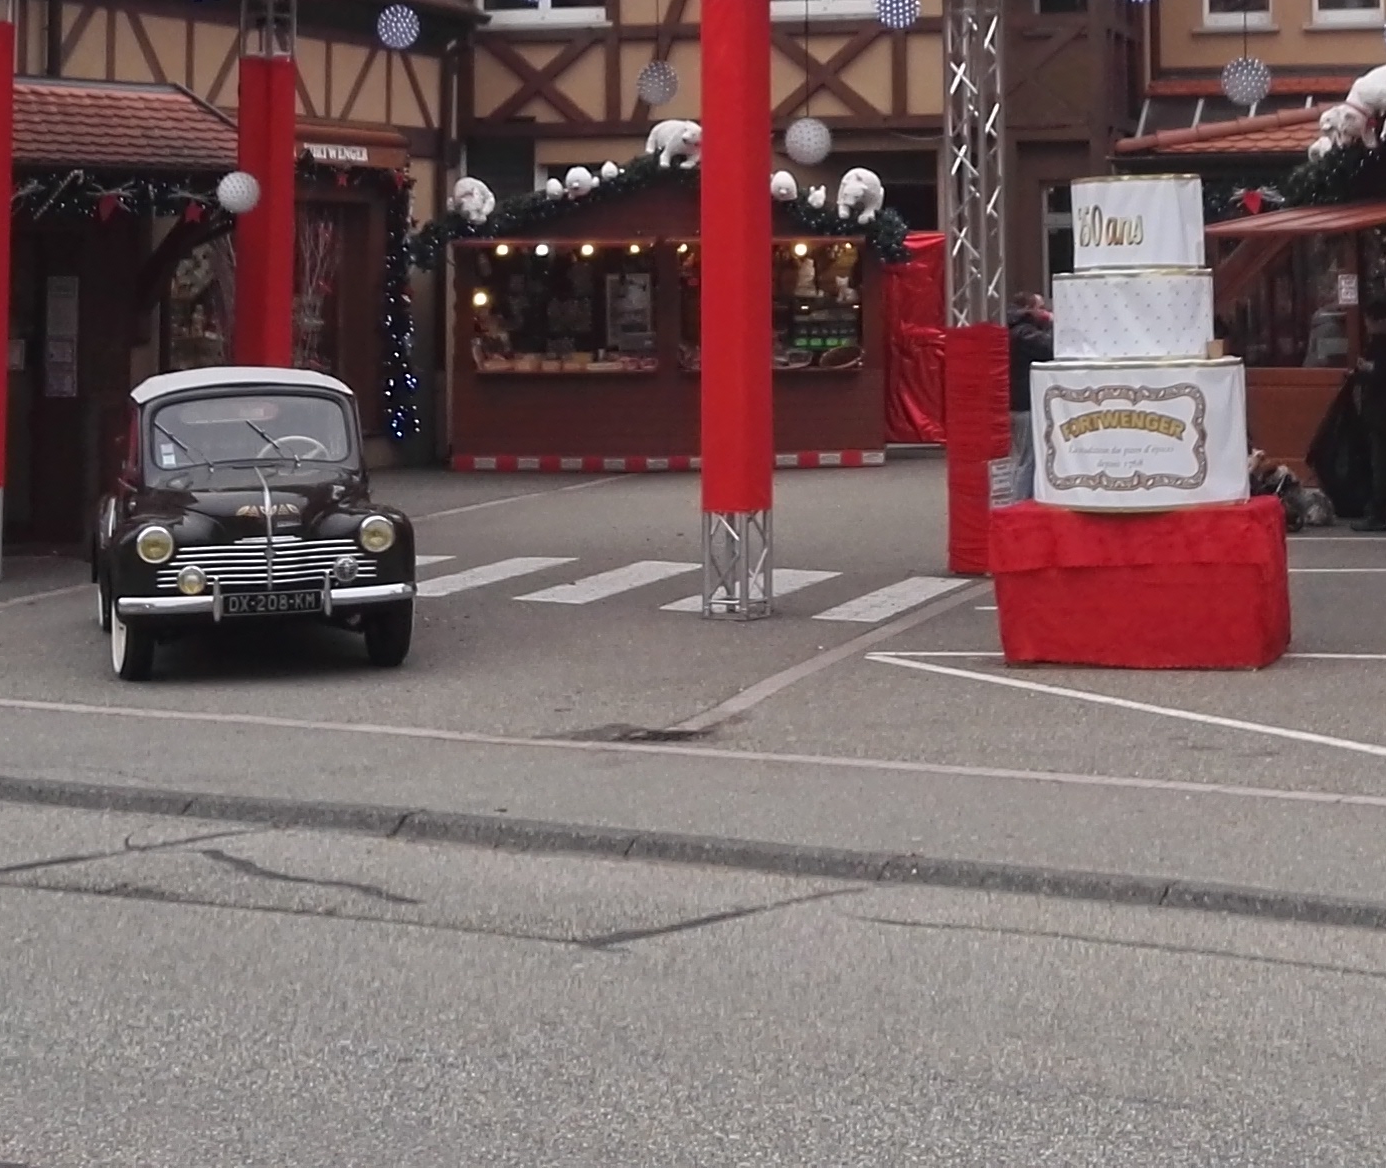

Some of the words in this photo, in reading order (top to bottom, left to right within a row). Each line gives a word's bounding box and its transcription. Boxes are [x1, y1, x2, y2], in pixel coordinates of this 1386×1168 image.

[1106, 215, 1144, 246] ans
[1059, 409, 1186, 442] FORTWENGER
[229, 594, 315, 611] DX-208-KM
